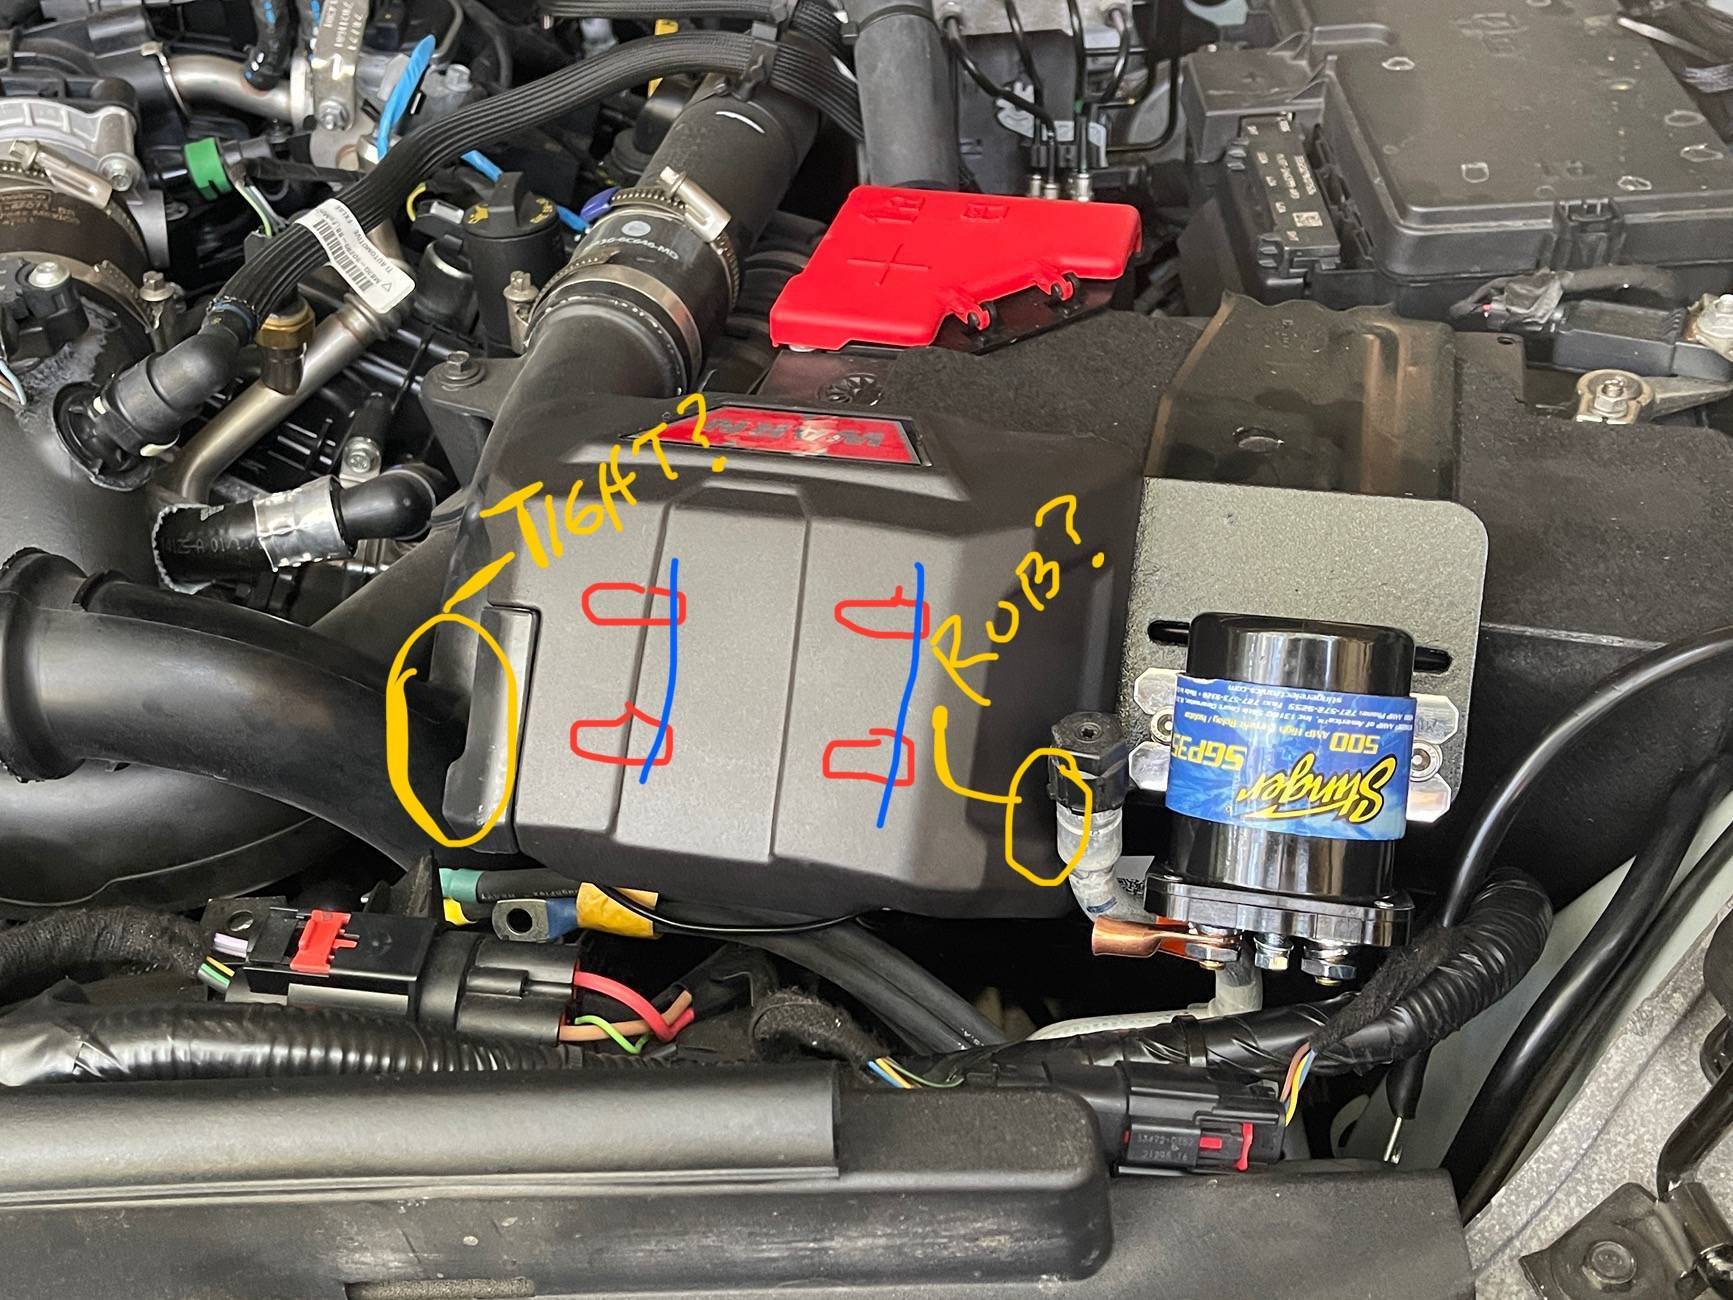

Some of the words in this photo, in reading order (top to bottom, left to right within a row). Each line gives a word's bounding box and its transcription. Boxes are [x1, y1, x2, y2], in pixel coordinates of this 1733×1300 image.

[1279, 723, 1304, 740] High
[1364, 720, 1375, 730] of
[1306, 728, 1331, 740] AMP
[1329, 731, 1381, 755] 500
[1236, 751, 1398, 824] Stinger
